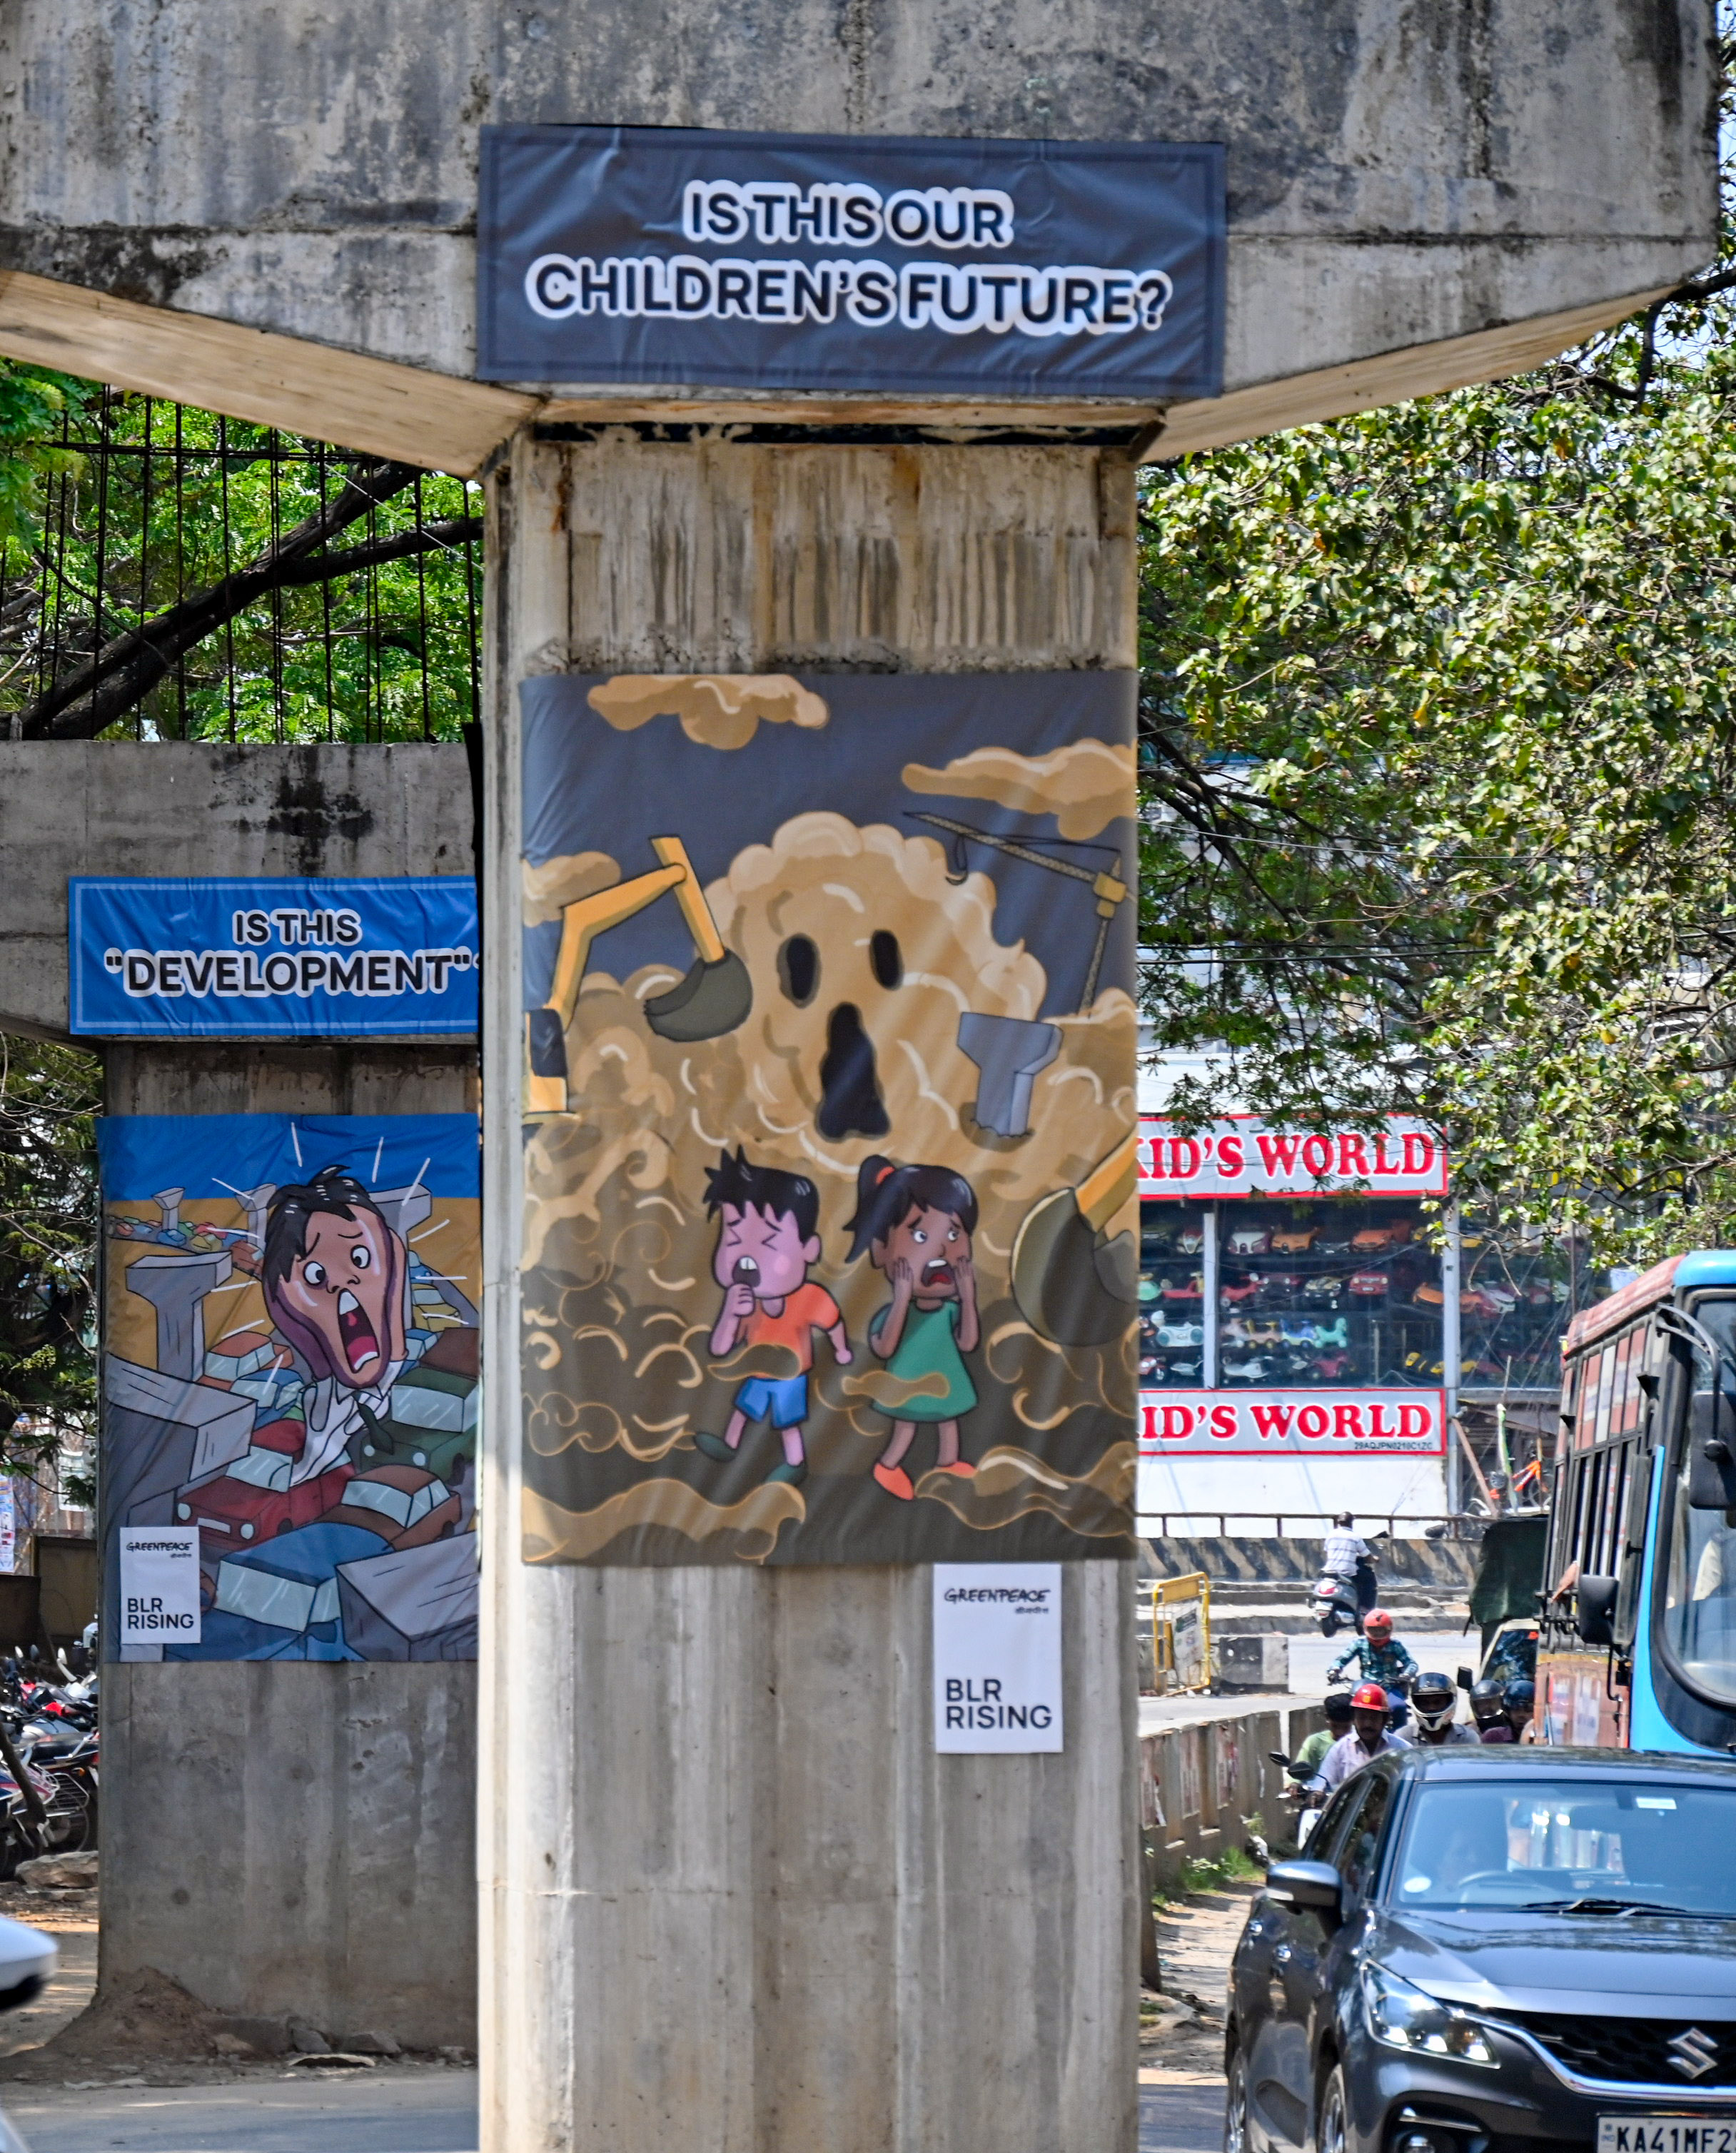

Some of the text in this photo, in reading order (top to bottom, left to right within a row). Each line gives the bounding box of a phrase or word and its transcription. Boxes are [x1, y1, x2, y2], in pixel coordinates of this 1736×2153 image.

[690, 191, 1006, 245] IS THIS OUR
[533, 261, 1169, 328] CHILDREN'S FUTURE?
[235, 912, 360, 944] IS THIS
[105, 952, 480, 993] "DEVELOPMENT"
[1256, 1133, 1435, 1177] WORLD
[1249, 1403, 1433, 1439] WORLD
[126, 1542, 193, 1552] GREENPEACE
[127, 1597, 163, 1613] BLR
[944, 1588, 1051, 1603] GREENPEACE
[127, 1614, 194, 1630] RISING
[946, 1678, 1001, 1702] BLR
[946, 1705, 1053, 1729] RISING
[1616, 2126, 1736, 2153] KA41MF2
